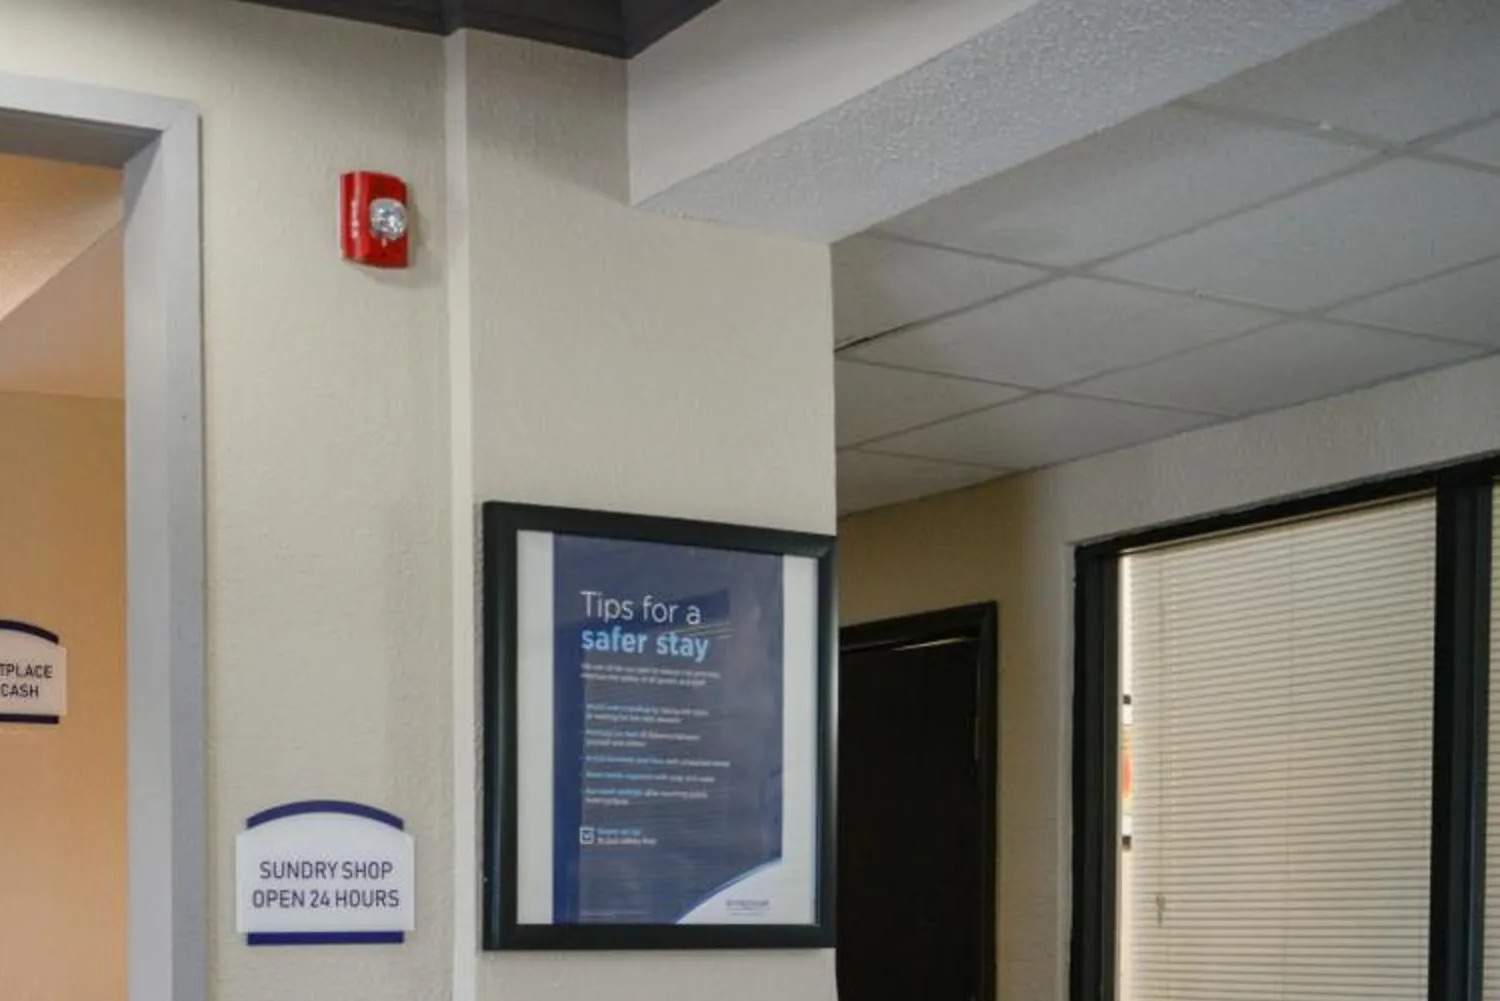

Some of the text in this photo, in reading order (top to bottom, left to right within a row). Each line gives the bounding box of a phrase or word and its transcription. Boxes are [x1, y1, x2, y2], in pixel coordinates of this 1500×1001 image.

[580, 590, 701, 625] Tips for a
[581, 625, 709, 663] safer stay
[1, 683, 39, 698] CASH
[259, 861, 393, 880] SUNDRY SHOP
[252, 889, 400, 909] OPEN 24 HOURS
